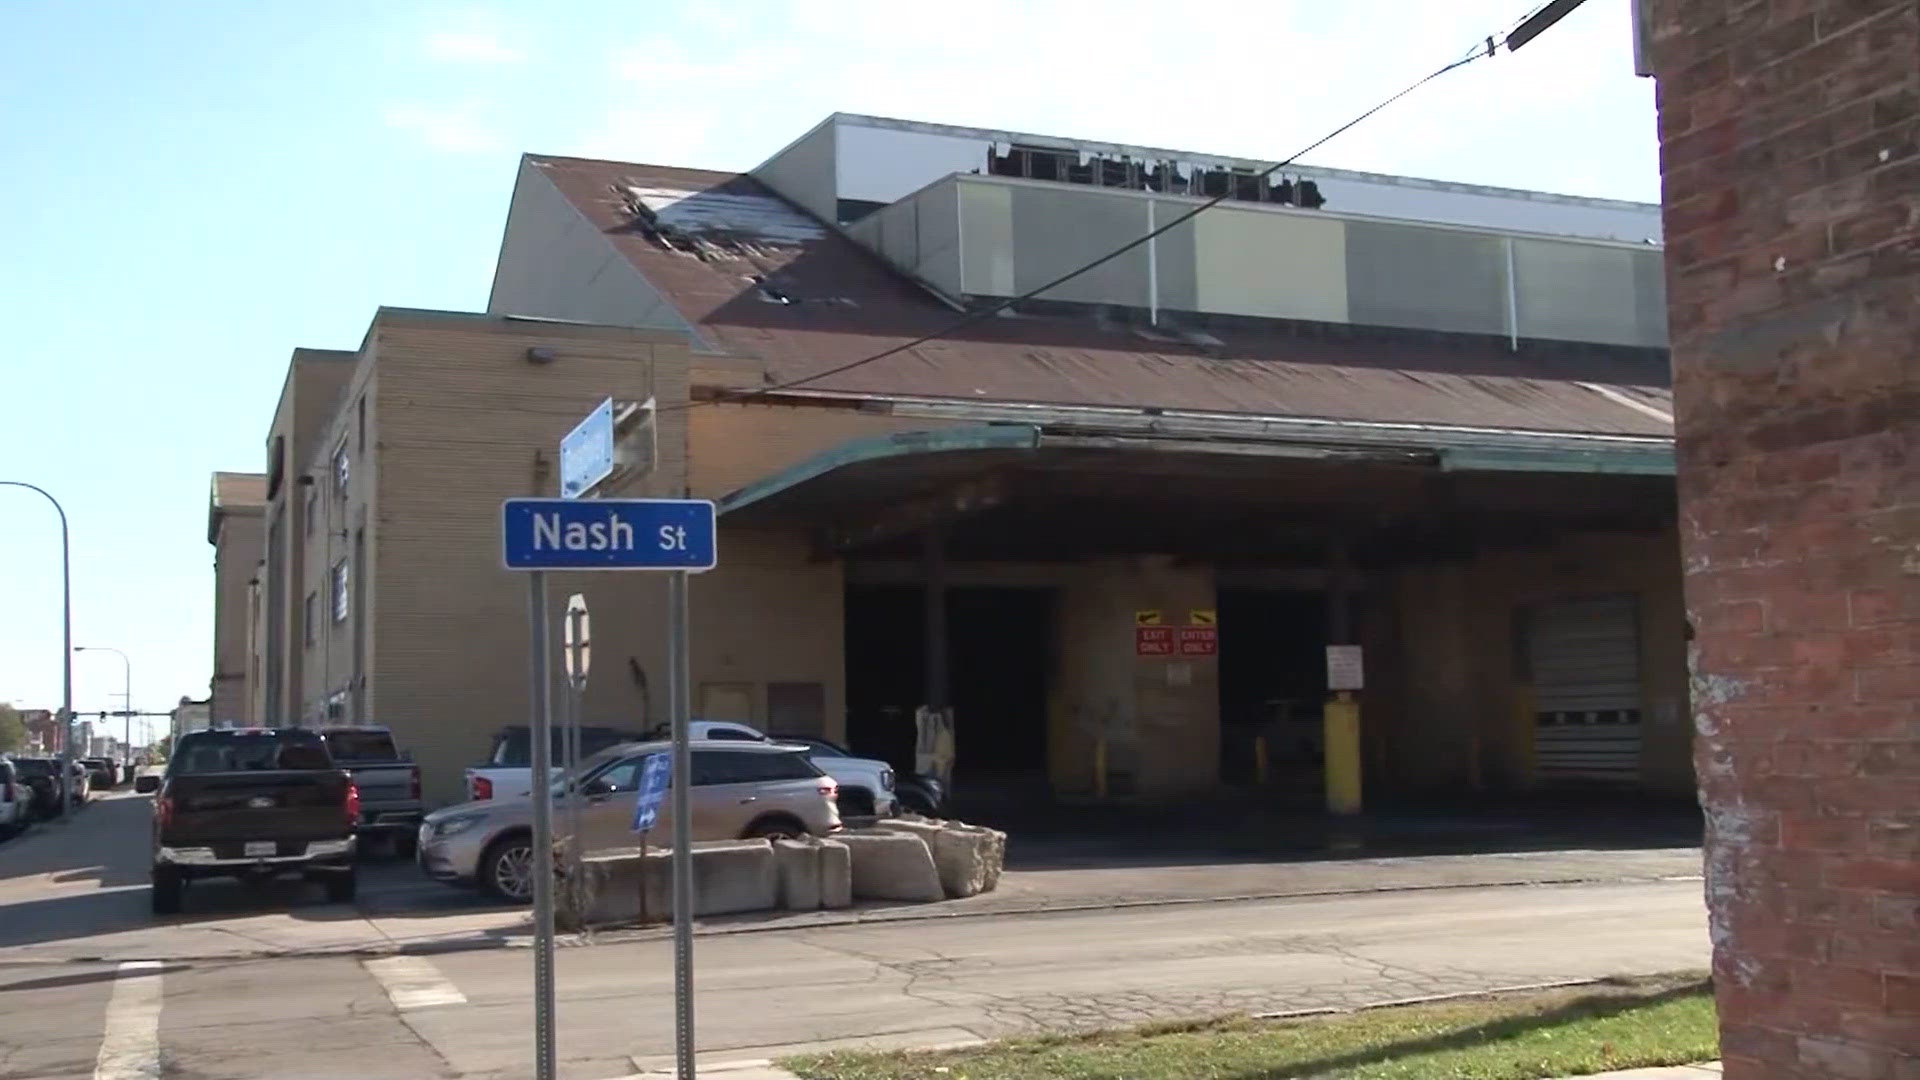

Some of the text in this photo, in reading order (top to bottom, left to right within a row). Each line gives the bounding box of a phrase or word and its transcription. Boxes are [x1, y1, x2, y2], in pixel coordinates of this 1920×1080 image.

[533, 513, 686, 551] Nash St
[1143, 630, 1166, 640] EXIT
[1181, 630, 1215, 640] ENTER
[1140, 642, 1169, 652] ONLY
[1183, 642, 1214, 652] ONLY
